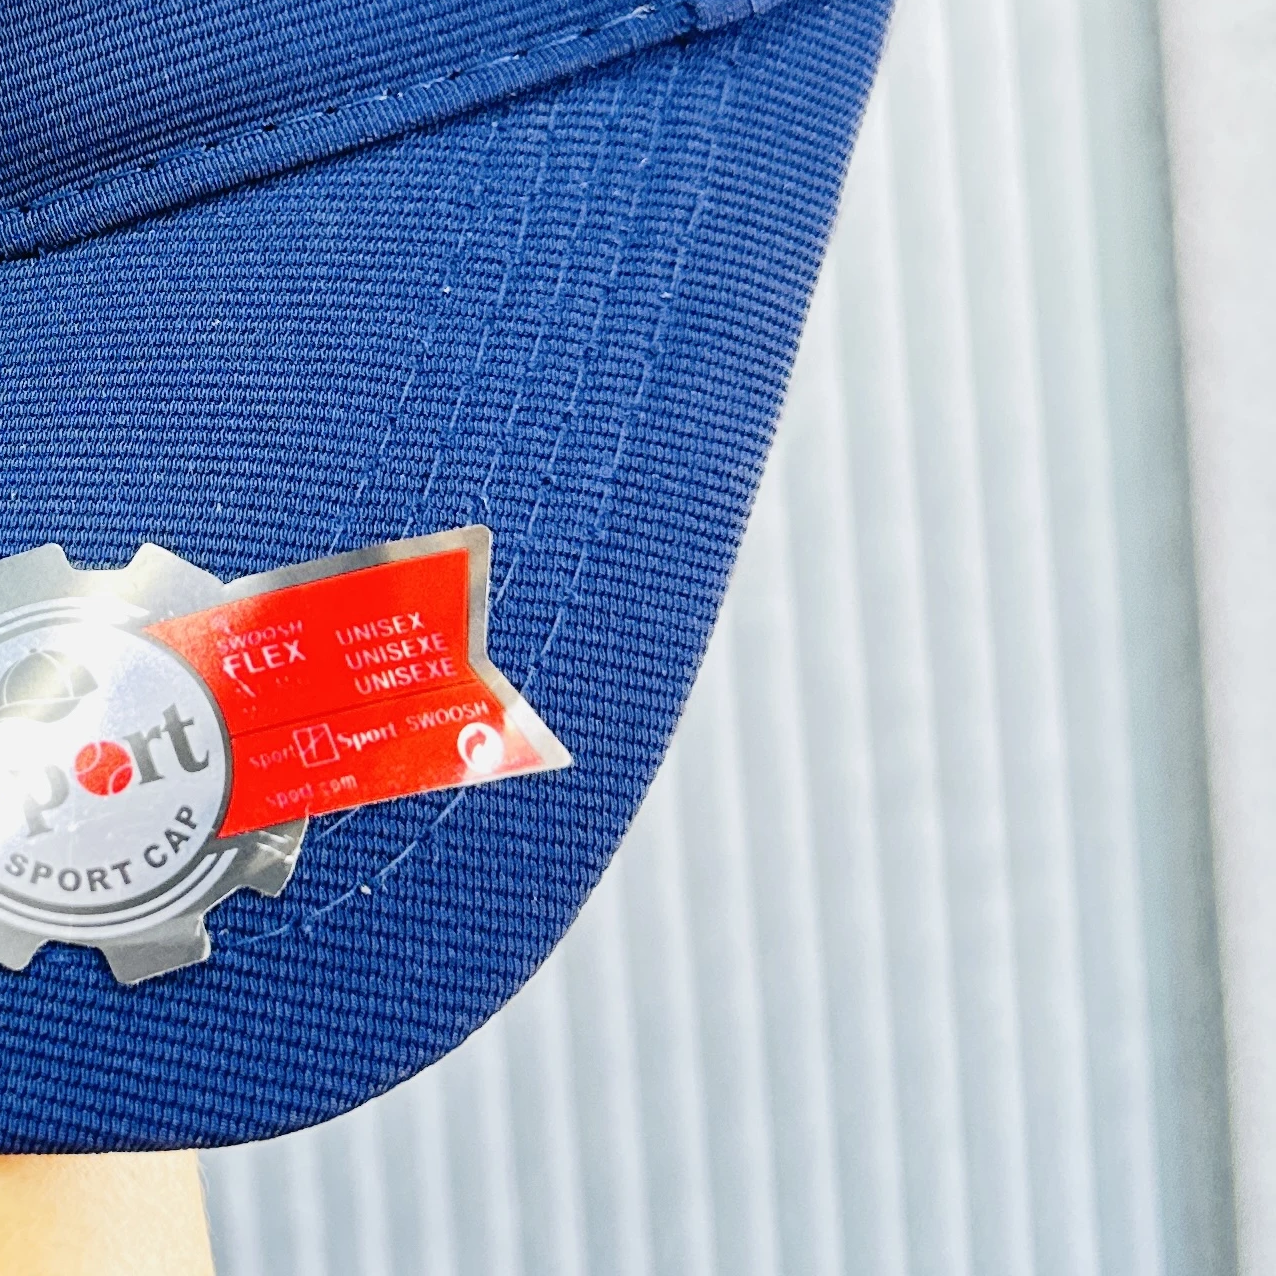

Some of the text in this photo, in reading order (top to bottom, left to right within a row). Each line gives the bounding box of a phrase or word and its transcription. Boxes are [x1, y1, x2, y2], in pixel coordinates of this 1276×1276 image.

[335, 612, 425, 646] UNISEX
[222, 640, 306, 679] FLEX
[345, 632, 449, 670] UNISEXE
[354, 657, 457, 695] UNISEXE
[405, 700, 490, 731] SWOOSH
[4, 804, 199, 893] SPORT CAP
